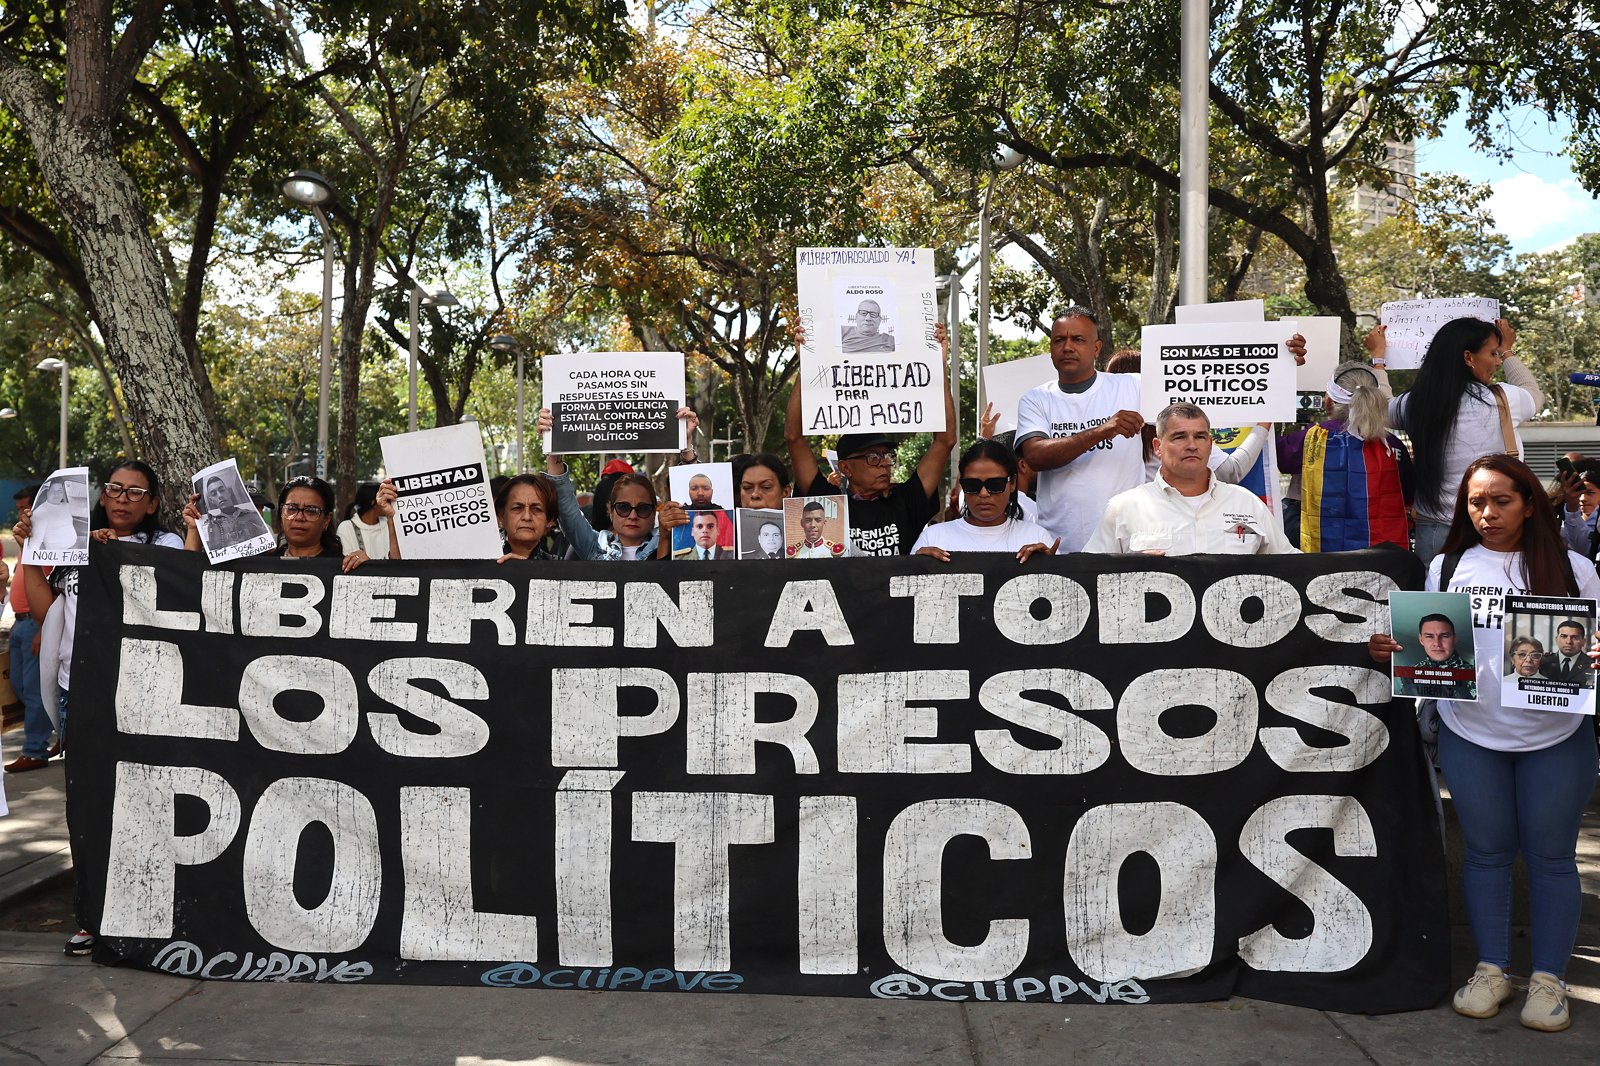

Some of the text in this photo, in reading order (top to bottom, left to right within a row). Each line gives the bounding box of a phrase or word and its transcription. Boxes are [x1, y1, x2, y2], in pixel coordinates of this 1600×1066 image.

[895, 248, 916, 265] YA!
[1162, 346, 1277, 358] SON MÁS DE 1.000
[569, 370, 656, 380] CADA HORA QUE
[1163, 362, 1270, 376] LOS PRESOS
[577, 380, 648, 390] PASAMOS SIN
[1164, 376, 1269, 393] POLÍTICOS
[559, 391, 665, 402] RESPUESTAS ES UNA
[836, 389, 869, 402] PARA
[1169, 395, 1266, 406] EN VENEZUELA
[561, 401, 669, 412] FORMA DE VIOLENCIA
[560, 411, 667, 422] ESTATAL CONTRA LAS
[809, 401, 923, 431] ALDO ROSO
[562, 421, 665, 432] FAMILIAS DE PRESOS
[1051, 422, 1078, 431] IBEREN
[1080, 422, 1086, 430] A
[586, 432, 639, 442] POLÍTICOS
[394, 467, 478, 492] LIBERTAD
[396, 485, 486, 511] PARA TODOS
[400, 498, 489, 524] LOS PRESOS
[402, 510, 491, 537] POLÍTICOS
[878, 523, 898, 538] LOS
[885, 533, 900, 547] DE
[1507, 587, 1514, 596] A
[118, 564, 1400, 649] LIBEREN A TODOS
[1526, 602, 1564, 611] MONASTERIOS
[1564, 604, 1589, 612] VANEGAS
[1524, 684, 1546, 692] DETENIDOS
[115, 636, 1391, 776] LOS PRESOS
[1527, 694, 1569, 707] LIBERTAD
[100, 760, 1378, 983] POLÍTICOS
